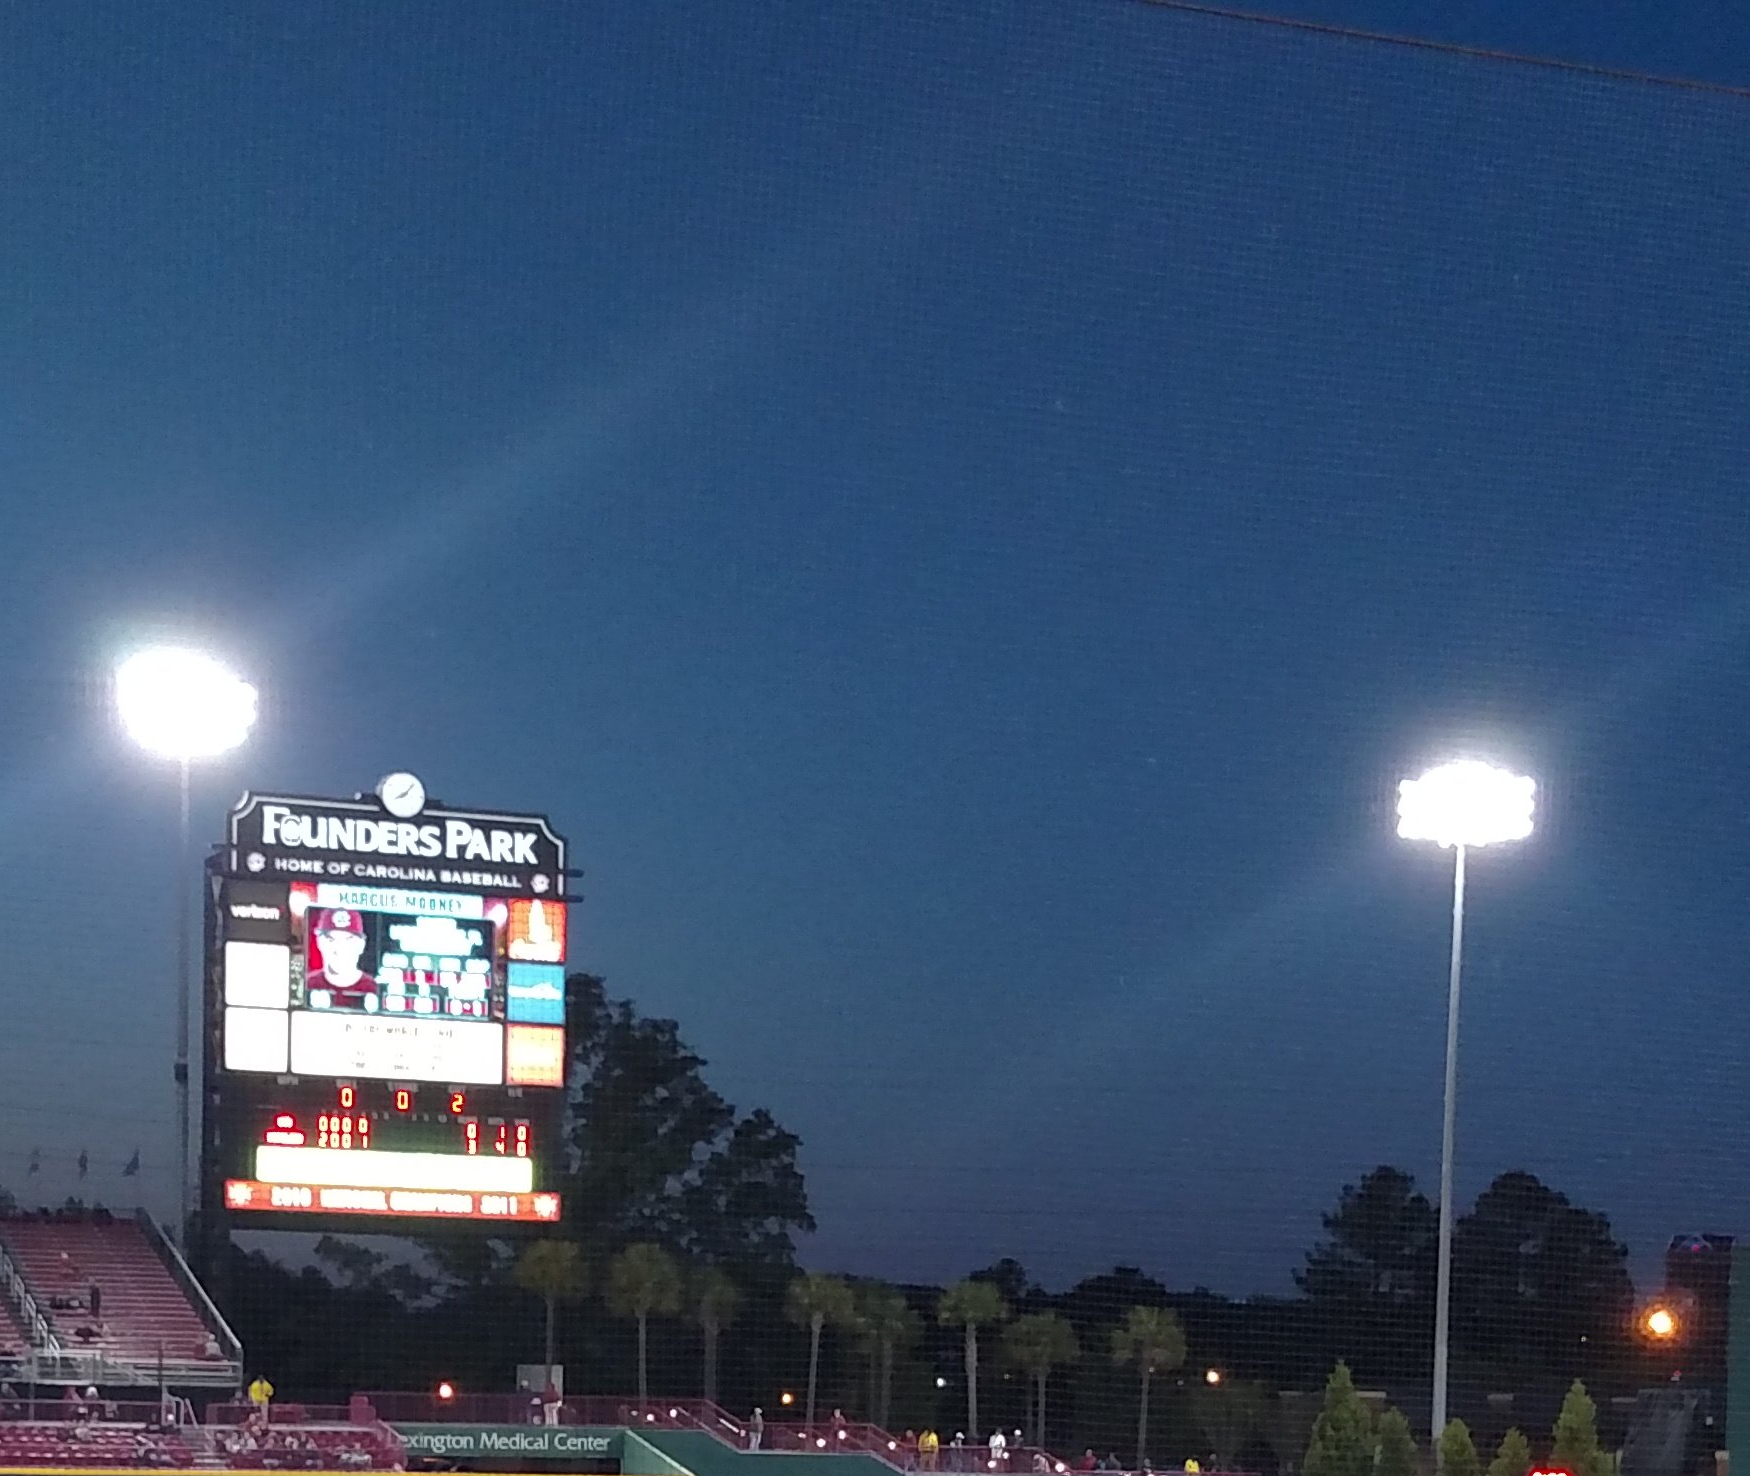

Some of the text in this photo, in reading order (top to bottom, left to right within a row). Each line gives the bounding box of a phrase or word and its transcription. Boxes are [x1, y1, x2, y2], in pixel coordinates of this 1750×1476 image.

[262, 805, 540, 865] FOUNDERS PARK
[274, 857, 523, 889] HOME OF CAROLINA BASEBALL
[341, 1087, 463, 1113] 0 0 2
[478, 1431, 549, 1451] Medical
[553, 1432, 612, 1451] Center
